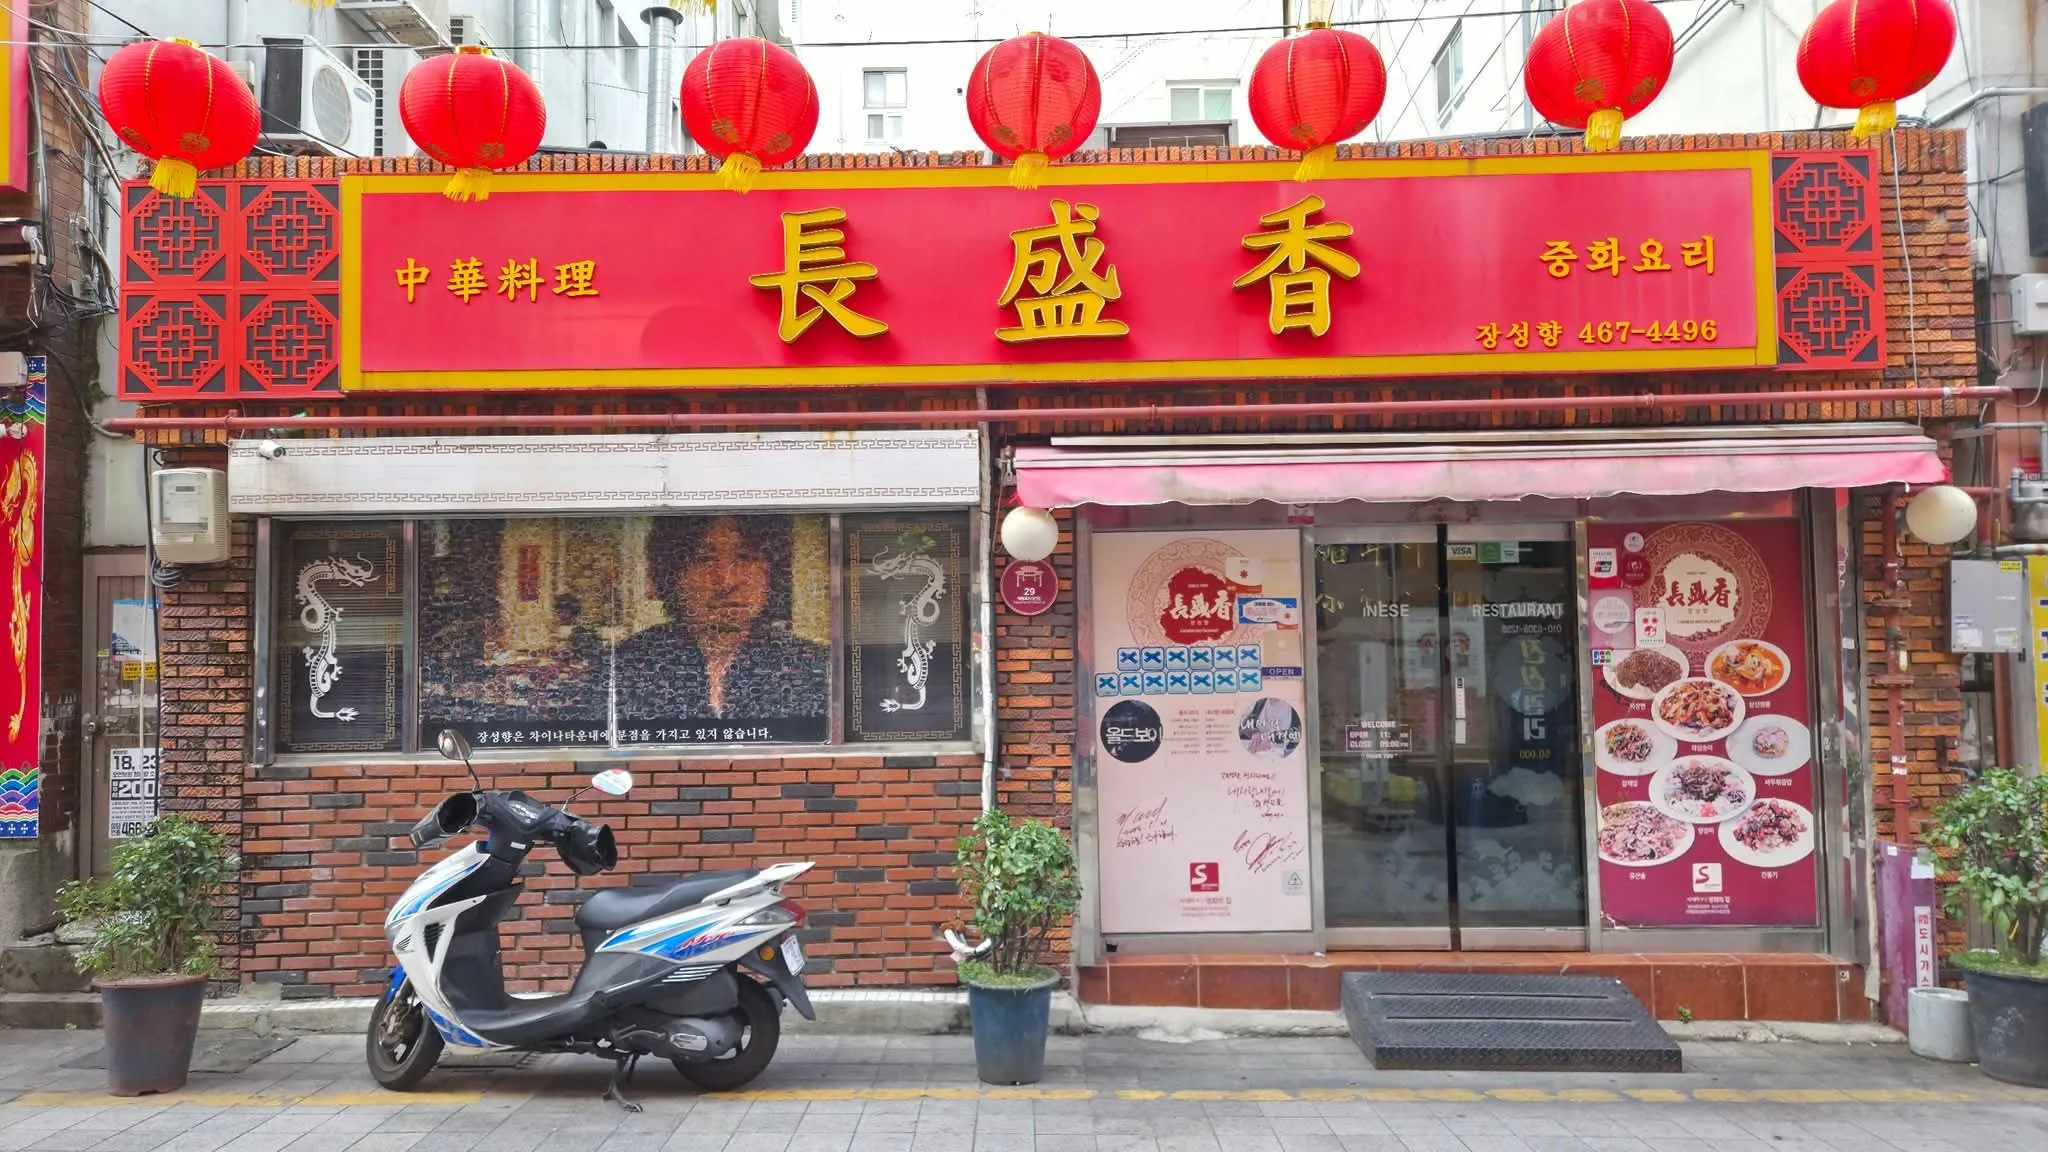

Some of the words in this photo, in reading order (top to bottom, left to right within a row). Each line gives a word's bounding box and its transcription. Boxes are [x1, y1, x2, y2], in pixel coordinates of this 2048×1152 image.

[1539, 235, 1715, 278] 중화요리
[750, 194, 1361, 343] 長盛香
[395, 256, 599, 303] 中華料理
[1476, 320, 1563, 349] 장성향
[1578, 319, 1718, 344] 467-4496
[1451, 547, 1472, 555] VISA
[1023, 587, 1036, 596] 29
[1471, 602, 1564, 618] RESTAURANT
[1268, 668, 1296, 677] OPEN
[1360, 720, 1396, 729] WELCOME
[477, 730, 524, 743] 장성향은
[529, 730, 610, 742] 차이나타운내에
[617, 729, 650, 741] 분점을
[656, 729, 690, 740] 가지고
[696, 729, 717, 741] 있지
[723, 728, 773, 740] 않습니다.
[1105, 726, 1164, 745] 올드보이
[1191, 864, 1208, 885] S
[1695, 866, 1710, 885] S
[1919, 928, 1930, 987] 도시가스
